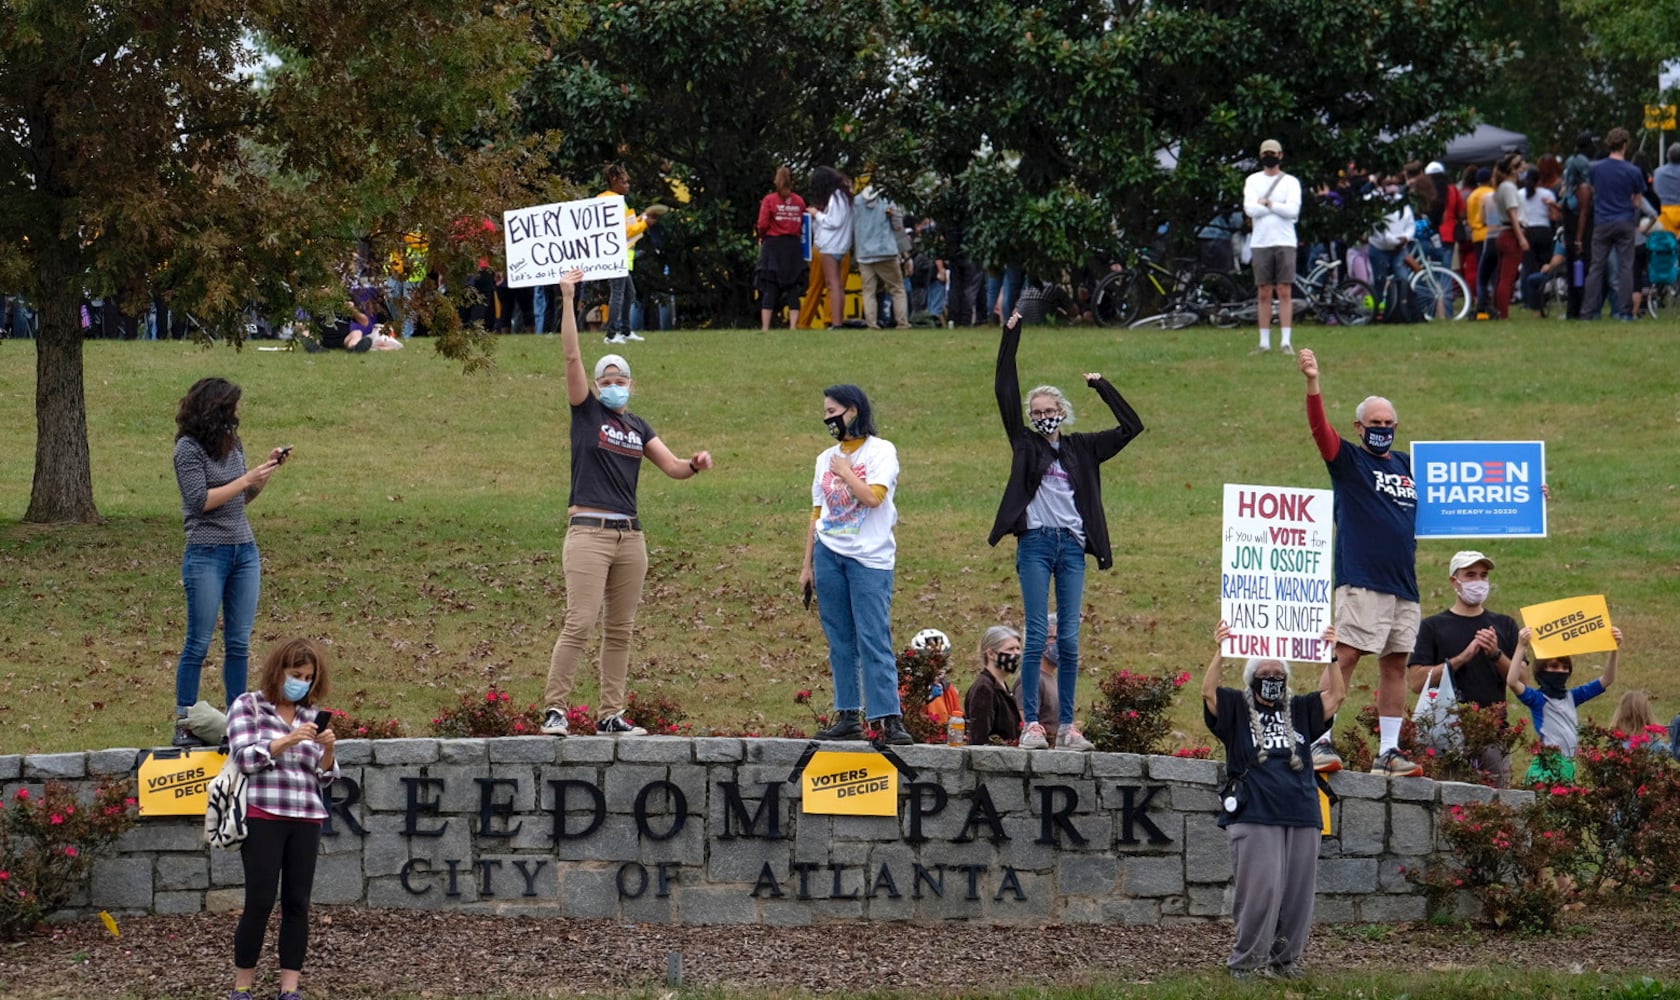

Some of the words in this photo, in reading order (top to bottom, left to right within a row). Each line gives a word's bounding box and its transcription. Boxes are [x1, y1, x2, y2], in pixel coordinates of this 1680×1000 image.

[507, 206, 562, 244] EVERY
[569, 202, 620, 231] VOTE
[531, 231, 620, 267] COUNTS
[1427, 461, 1528, 483] BIDEN
[1238, 491, 1316, 523] HONK
[1427, 485, 1530, 503] HARRIS
[1254, 531, 1268, 544] will
[1269, 526, 1307, 546] VOTE
[1311, 530, 1327, 547] for
[1231, 545, 1263, 570] JON
[1270, 548, 1322, 574] OSSOFF
[1223, 573, 1271, 600] RAPHAEL
[1274, 576, 1330, 604] WARNOCK
[1275, 605, 1324, 633] RUNOFF
[1535, 610, 1585, 635] VOTERS
[1561, 619, 1605, 641] DECIDE
[1227, 634, 1270, 657] TURN
[1276, 637, 1289, 658] IT
[1292, 637, 1330, 661] BLUE!
[147, 767, 206, 788] VOTERS
[174, 782, 210, 798] DECI
[811, 768, 868, 786] VOTERS
[837, 780, 889, 798] DECIDE
[320, 778, 788, 840] REEDOM
[903, 781, 1175, 846] PARK
[400, 858, 549, 898] CITY
[616, 860, 682, 898] OF
[750, 861, 1029, 900] ATLANTA
